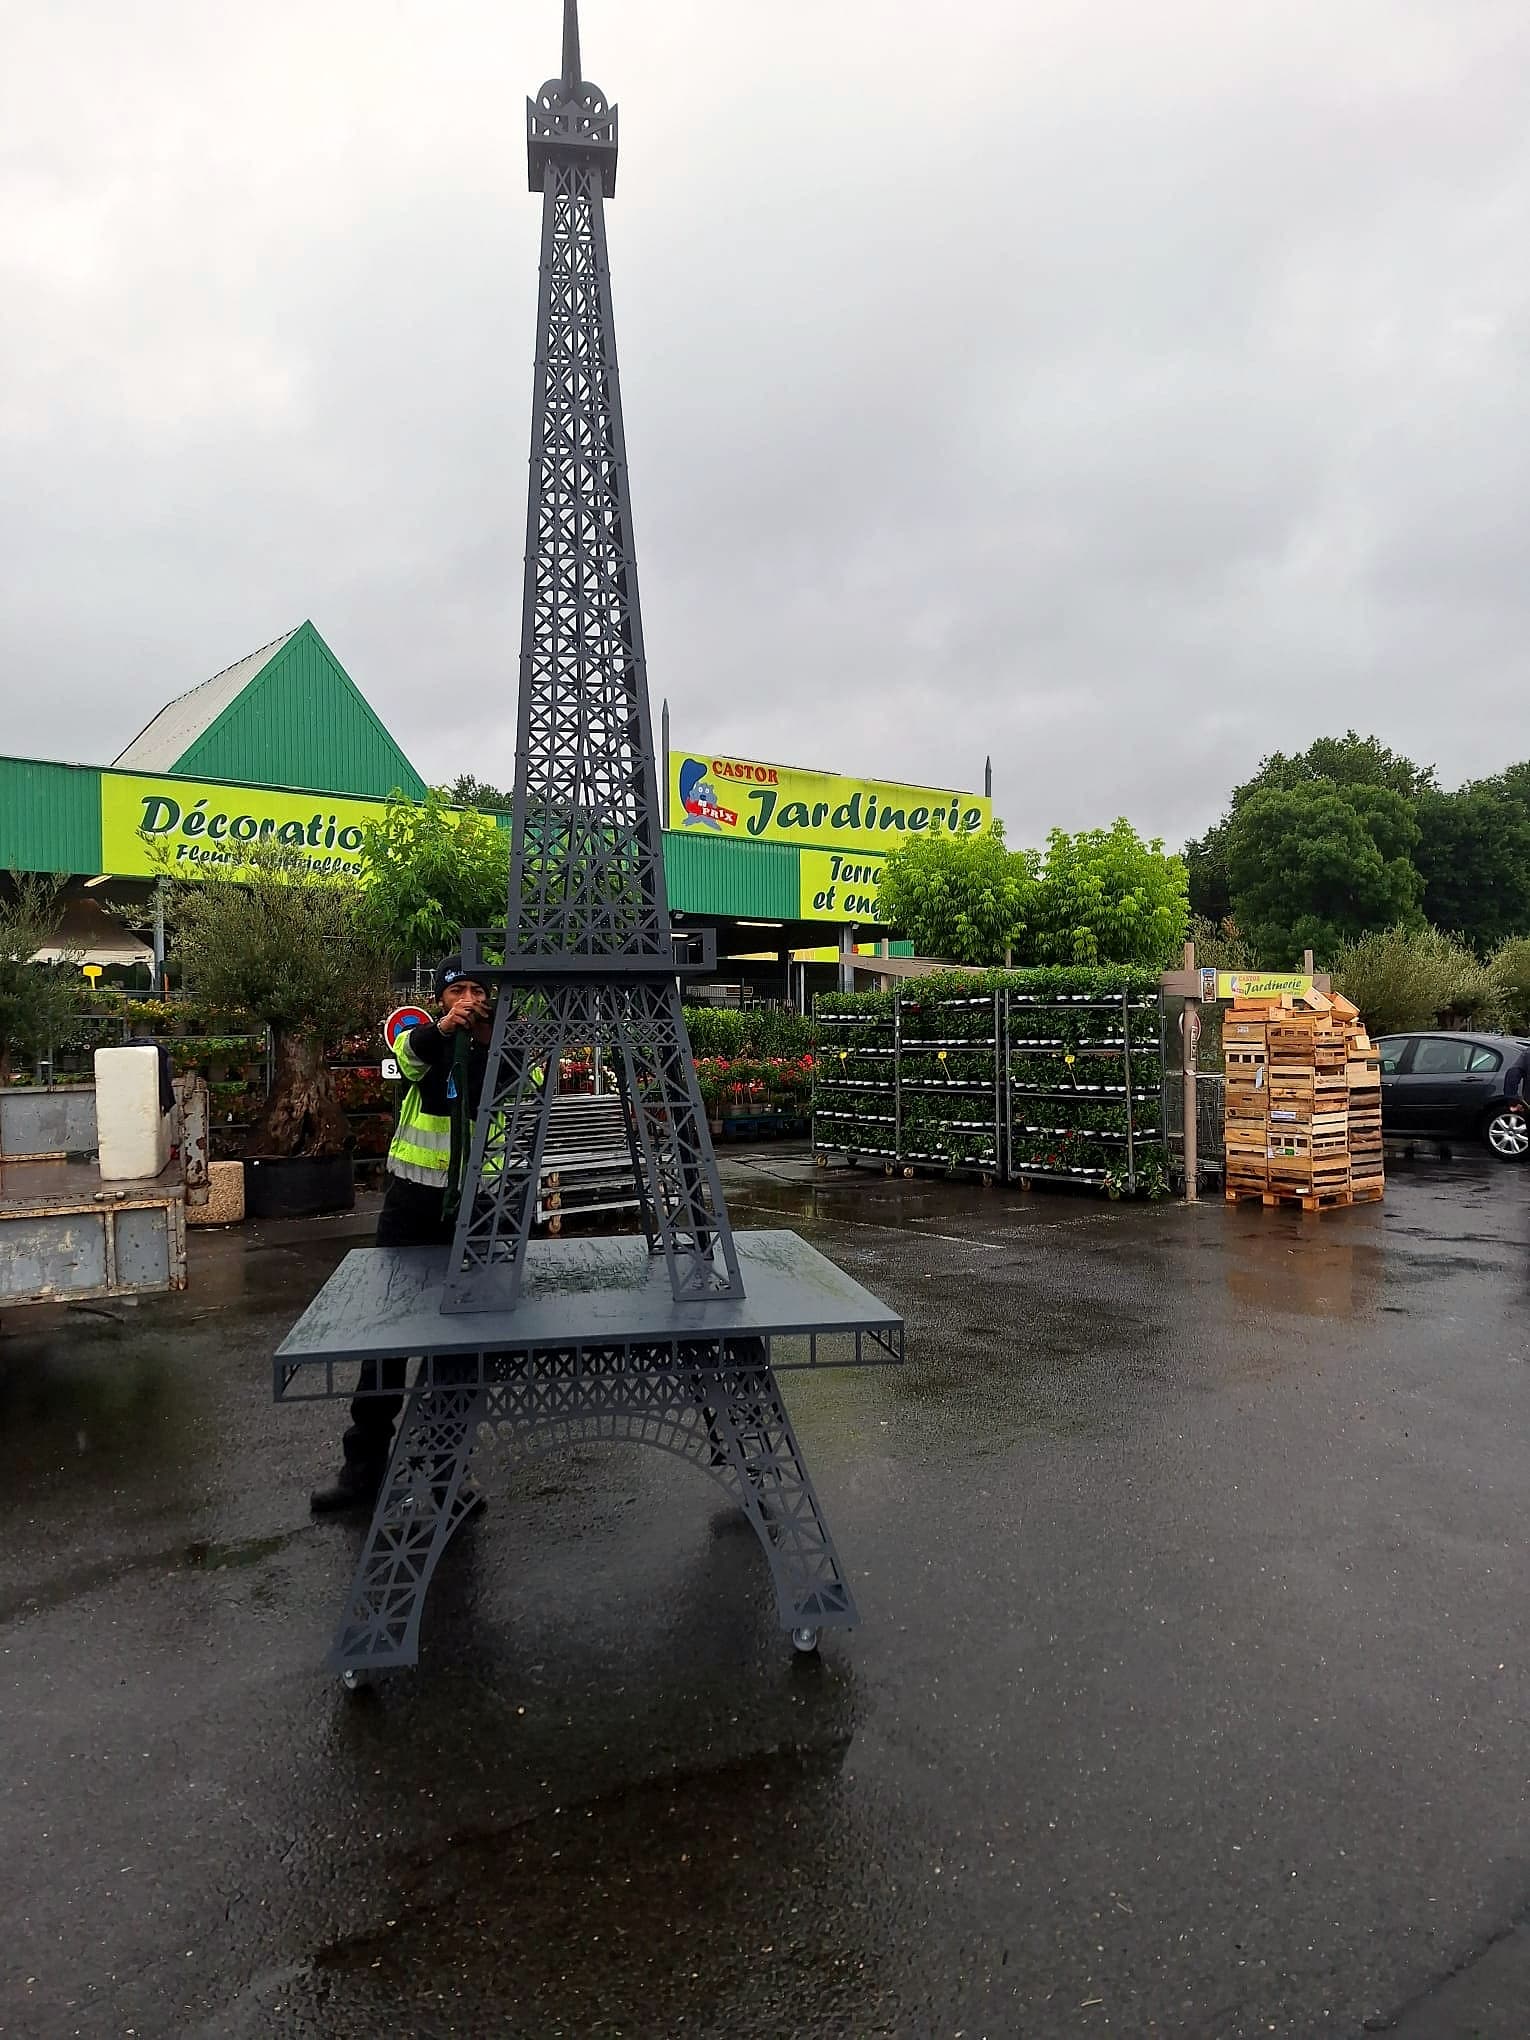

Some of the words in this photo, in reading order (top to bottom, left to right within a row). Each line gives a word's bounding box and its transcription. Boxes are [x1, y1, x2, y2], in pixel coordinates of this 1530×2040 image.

[712, 760, 779, 784] CASTOR
[141, 796, 386, 851] Décoratio
[702, 807, 734, 822] PRIX
[746, 789, 982, 836] Jardinerie
[813, 886, 836, 910] et
[1244, 978, 1302, 995] Jardinerie
